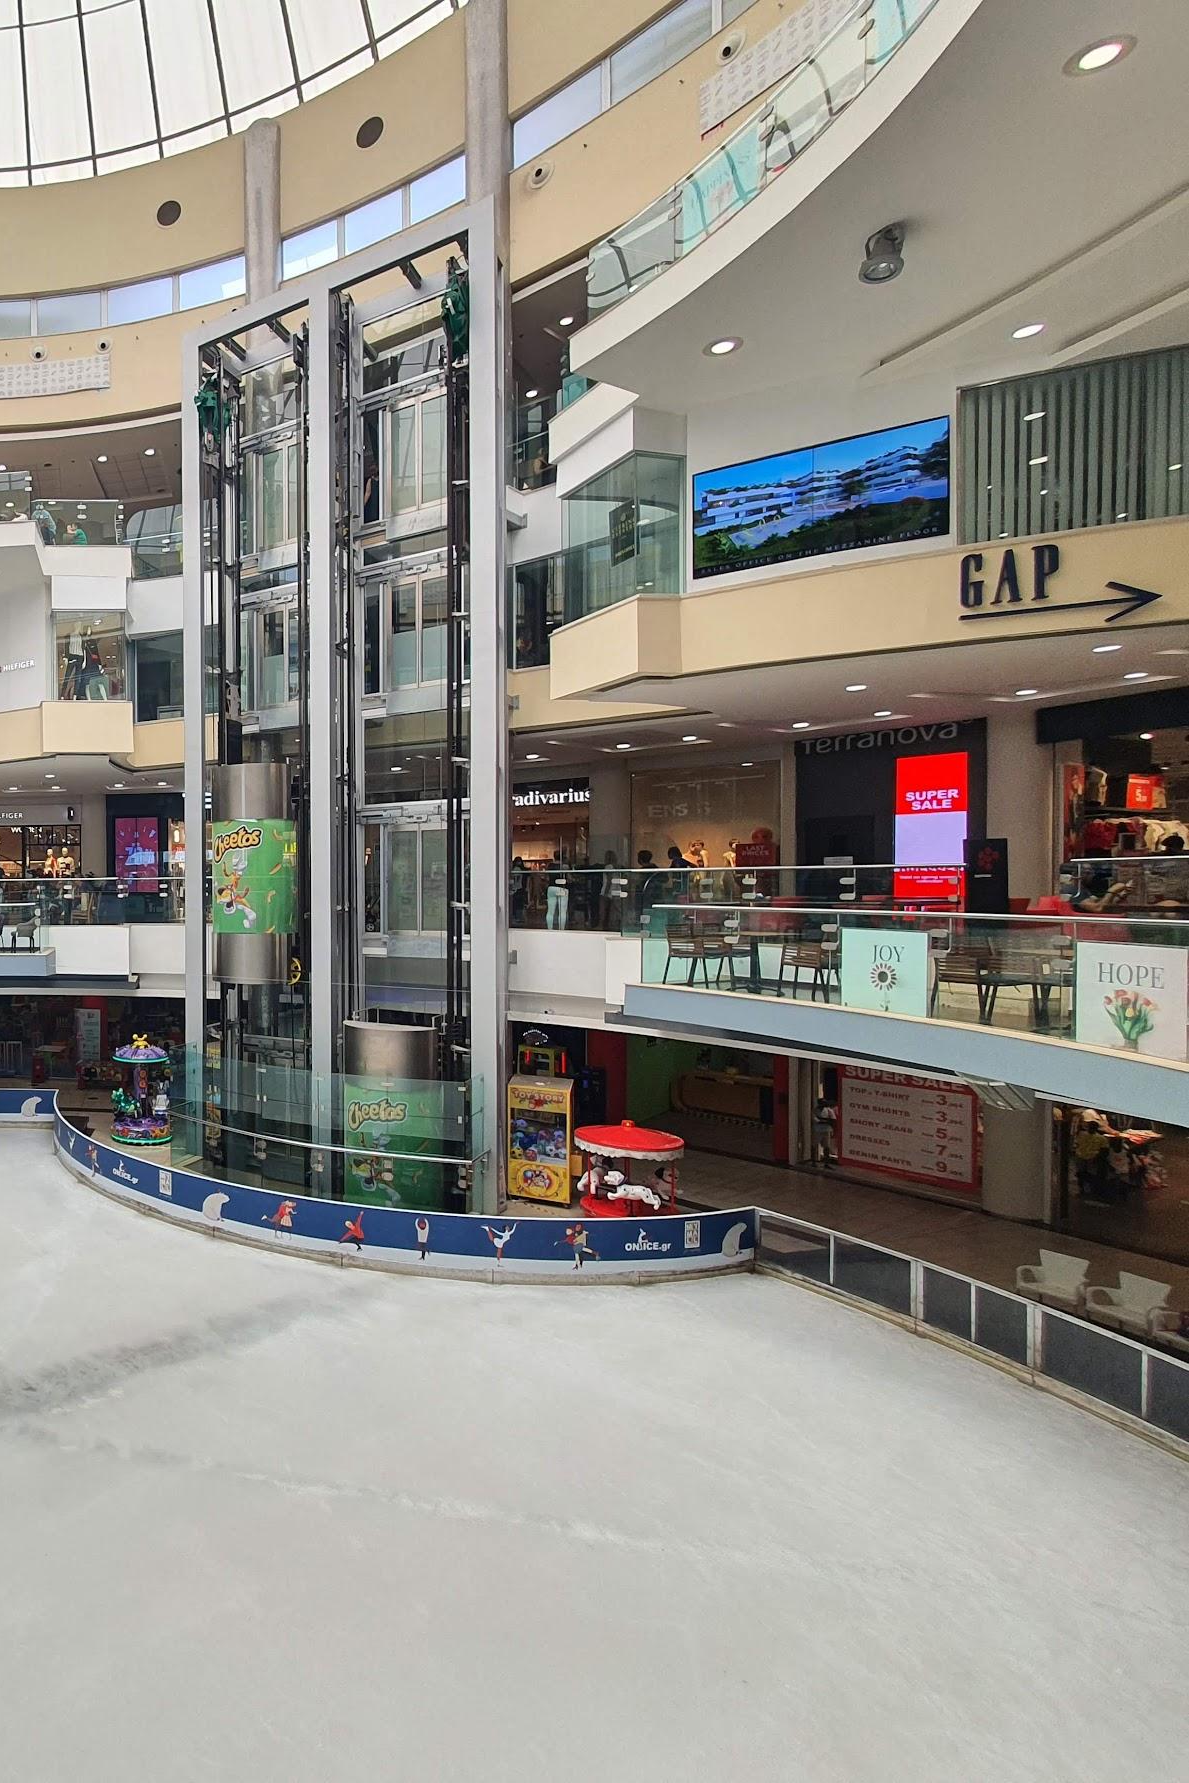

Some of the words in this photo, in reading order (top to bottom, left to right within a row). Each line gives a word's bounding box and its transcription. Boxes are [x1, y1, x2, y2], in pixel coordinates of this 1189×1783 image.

[701, 564, 731, 574] SALES
[735, 556, 771, 567] OFFICE
[777, 553, 793, 561] ON
[798, 548, 819, 557] THE
[825, 535, 893, 553] MEZZANINE
[899, 526, 939, 539] FLOOR
[960, 544, 1060, 609] GAP
[3, 659, 35, 672] HILFIGER
[512, 788, 590, 806] adivarius
[905, 789, 959, 801] SUPER
[911, 799, 952, 810] SALE
[213, 826, 262, 863] Cheetos
[871, 944, 906, 964] JOY
[1097, 961, 1165, 989] HOPE
[844, 1066, 908, 1084] SUPER
[513, 1090, 531, 1099] TOY
[534, 1092, 564, 1103] STORY
[348, 1097, 408, 1131] Cheetos
[849, 1102, 870, 1111] GYM
[872, 1106, 911, 1117] SHORTS
[850, 1118, 881, 1128] SHORT
[882, 1124, 913, 1134] JEANS
[849, 1134, 891, 1146] DRESSES
[849, 1149, 879, 1160] DENIM
[881, 1155, 912, 1166] PANTS
